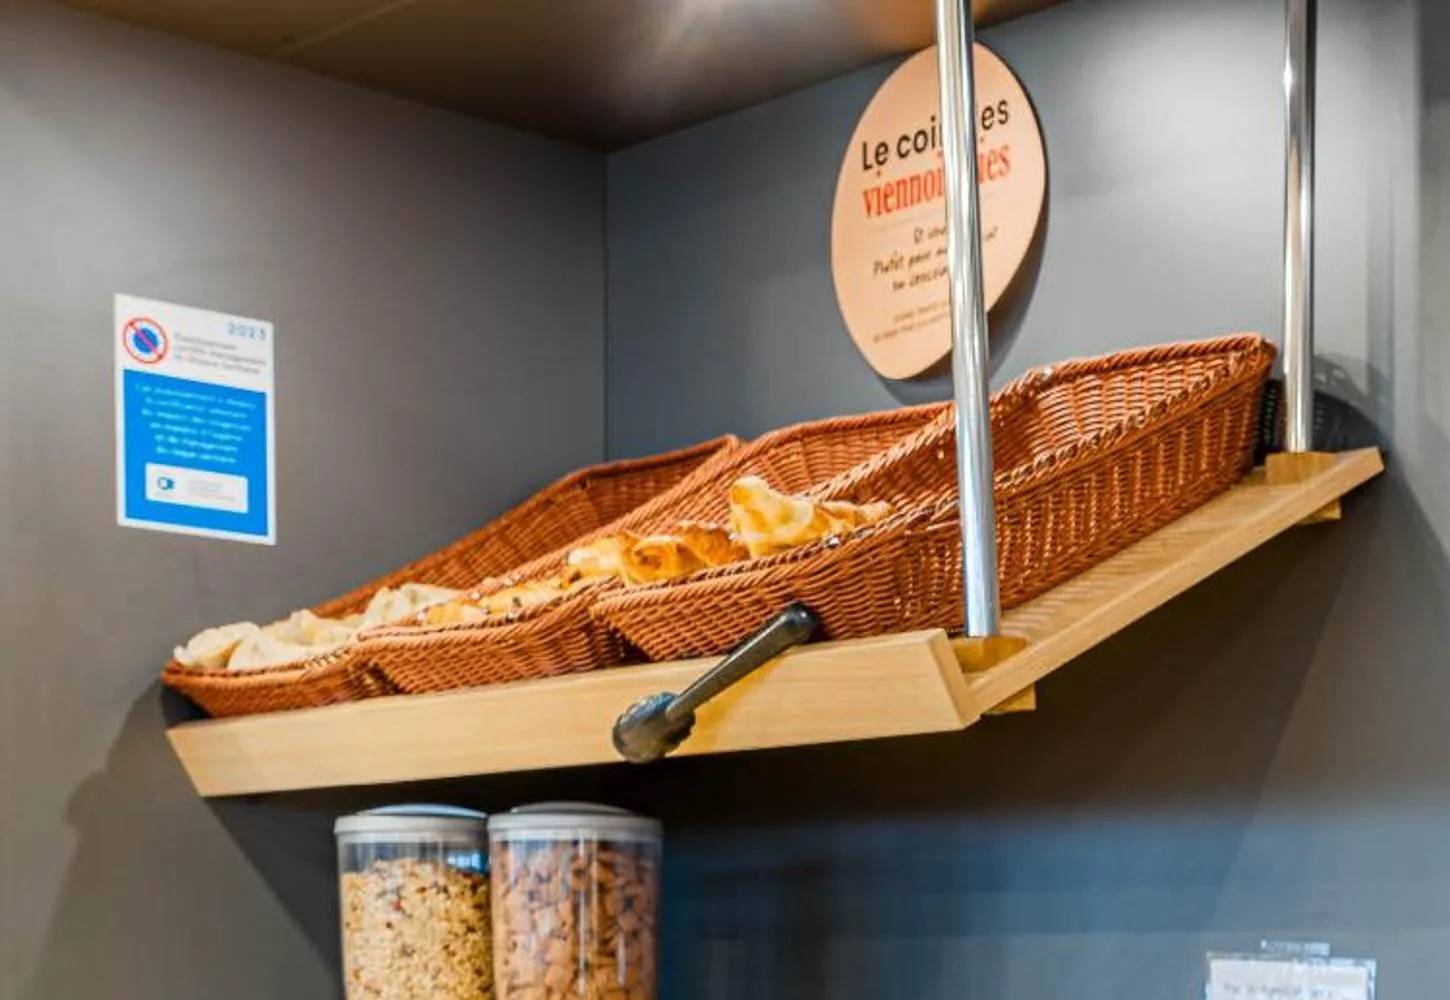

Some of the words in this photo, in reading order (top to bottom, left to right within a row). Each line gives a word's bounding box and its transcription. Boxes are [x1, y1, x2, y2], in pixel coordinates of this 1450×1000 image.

[862, 141, 889, 171] Le
[896, 115, 944, 159] coi
[980, 99, 1010, 131] es
[862, 144, 1012, 218] viennoiies
